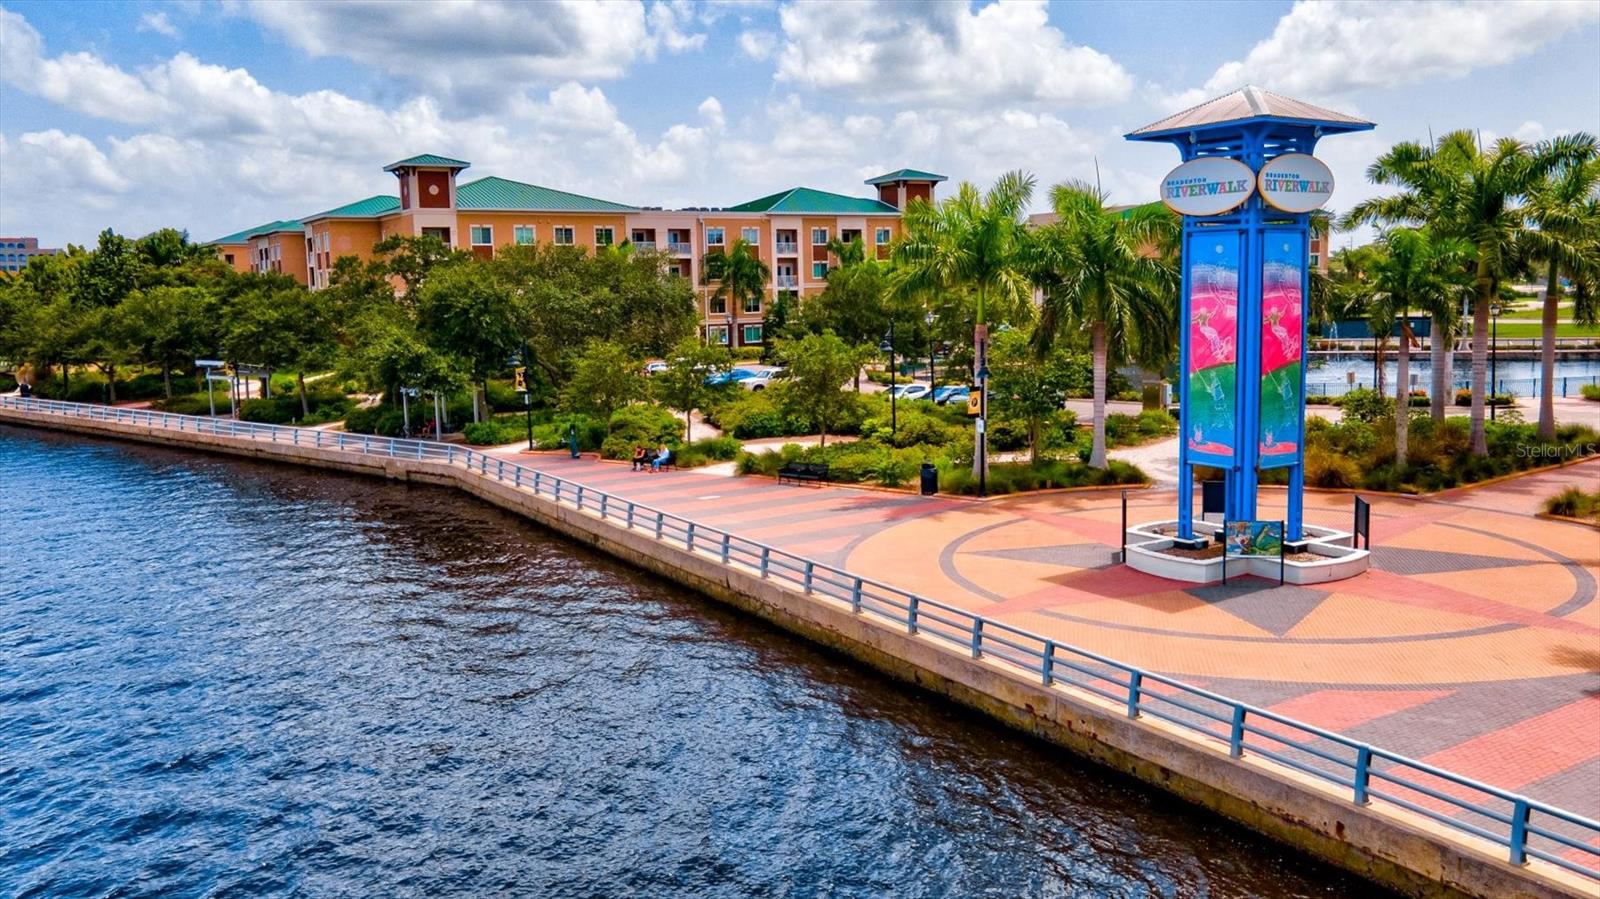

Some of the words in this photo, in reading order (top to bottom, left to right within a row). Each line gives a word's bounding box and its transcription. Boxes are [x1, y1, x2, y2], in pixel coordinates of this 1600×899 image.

[1166, 179, 1248, 199] RIVERWALK
[1167, 177, 1207, 186] BRADENTON
[1265, 178, 1330, 193] RIVERWALK
